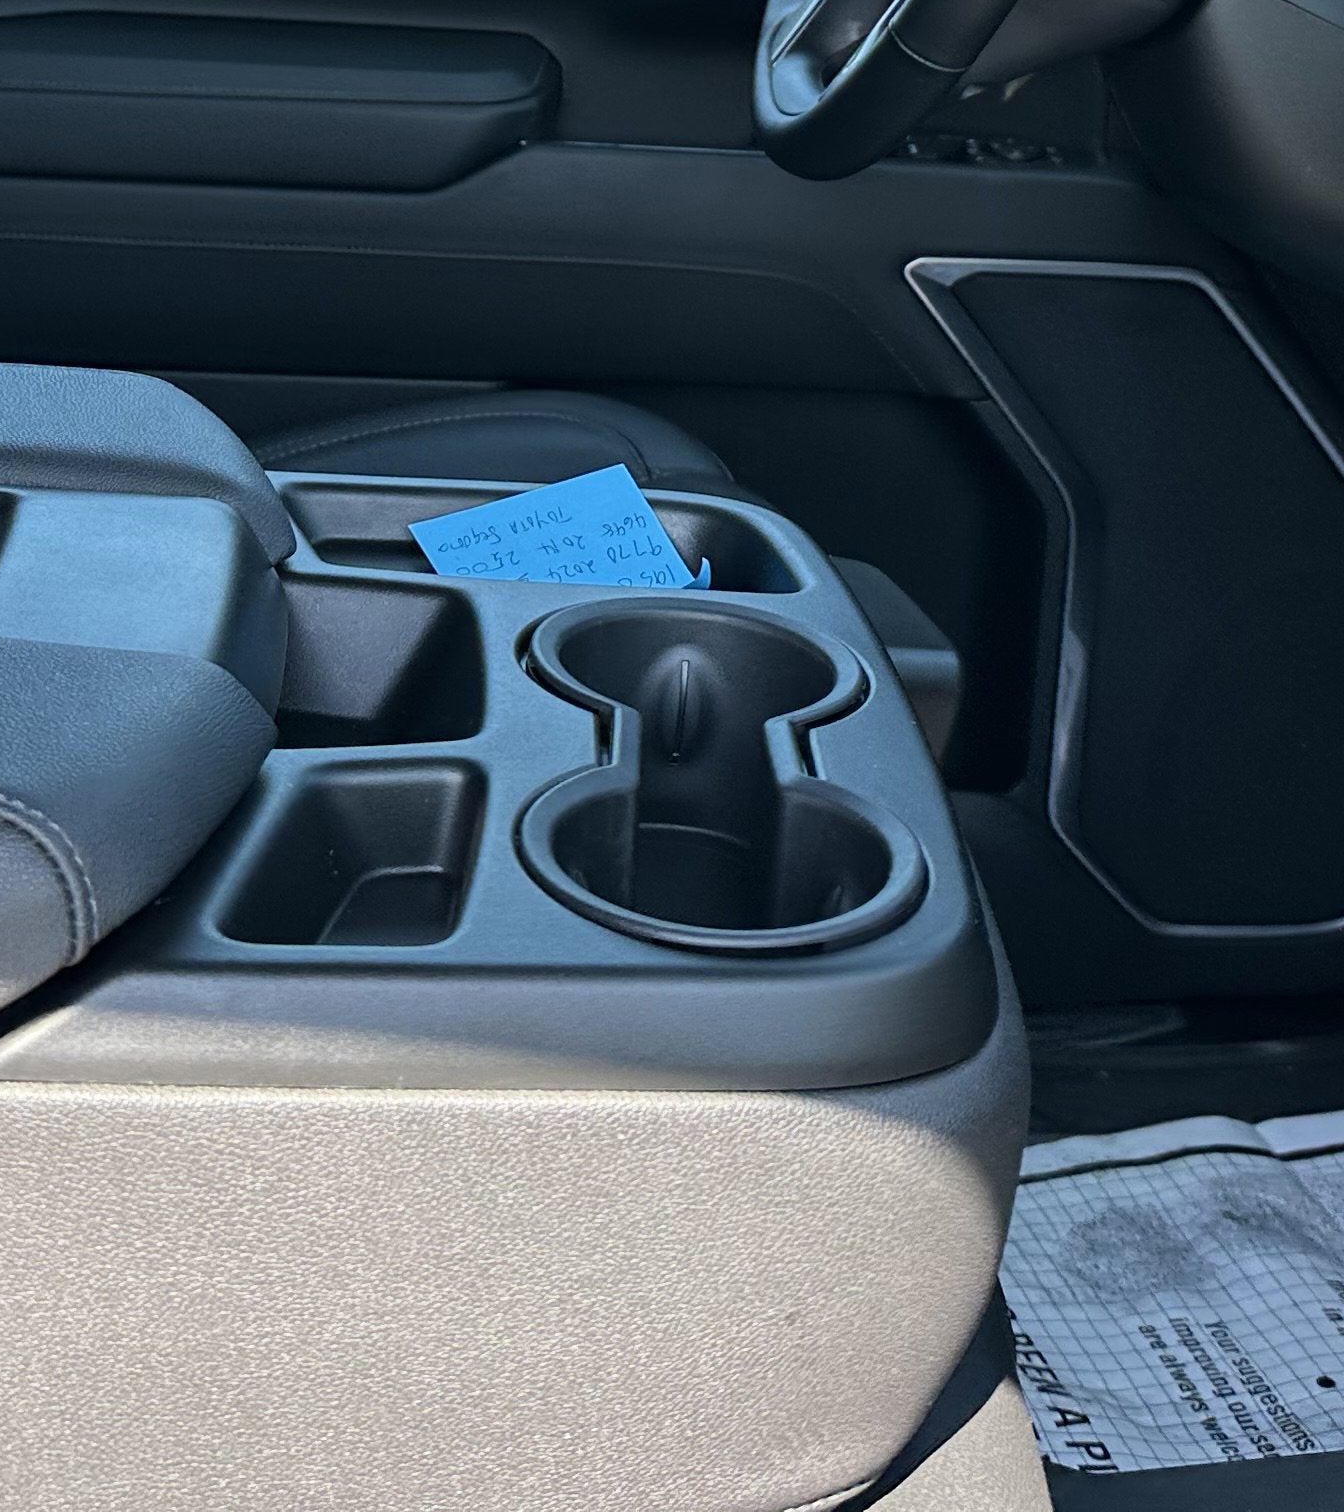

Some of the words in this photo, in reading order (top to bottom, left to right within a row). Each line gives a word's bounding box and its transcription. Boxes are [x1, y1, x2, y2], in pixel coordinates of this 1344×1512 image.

[1323, 1305, 1344, 1322] in
[1137, 1323, 1167, 1351] are
[1158, 1354, 1210, 1414] always
[1169, 1315, 1237, 1399] improving
[1227, 1400, 1260, 1432] our
[1204, 1320, 1240, 1355] Your
[1231, 1355, 1316, 1453] suggestions
[1046, 1404, 1091, 1428] A
